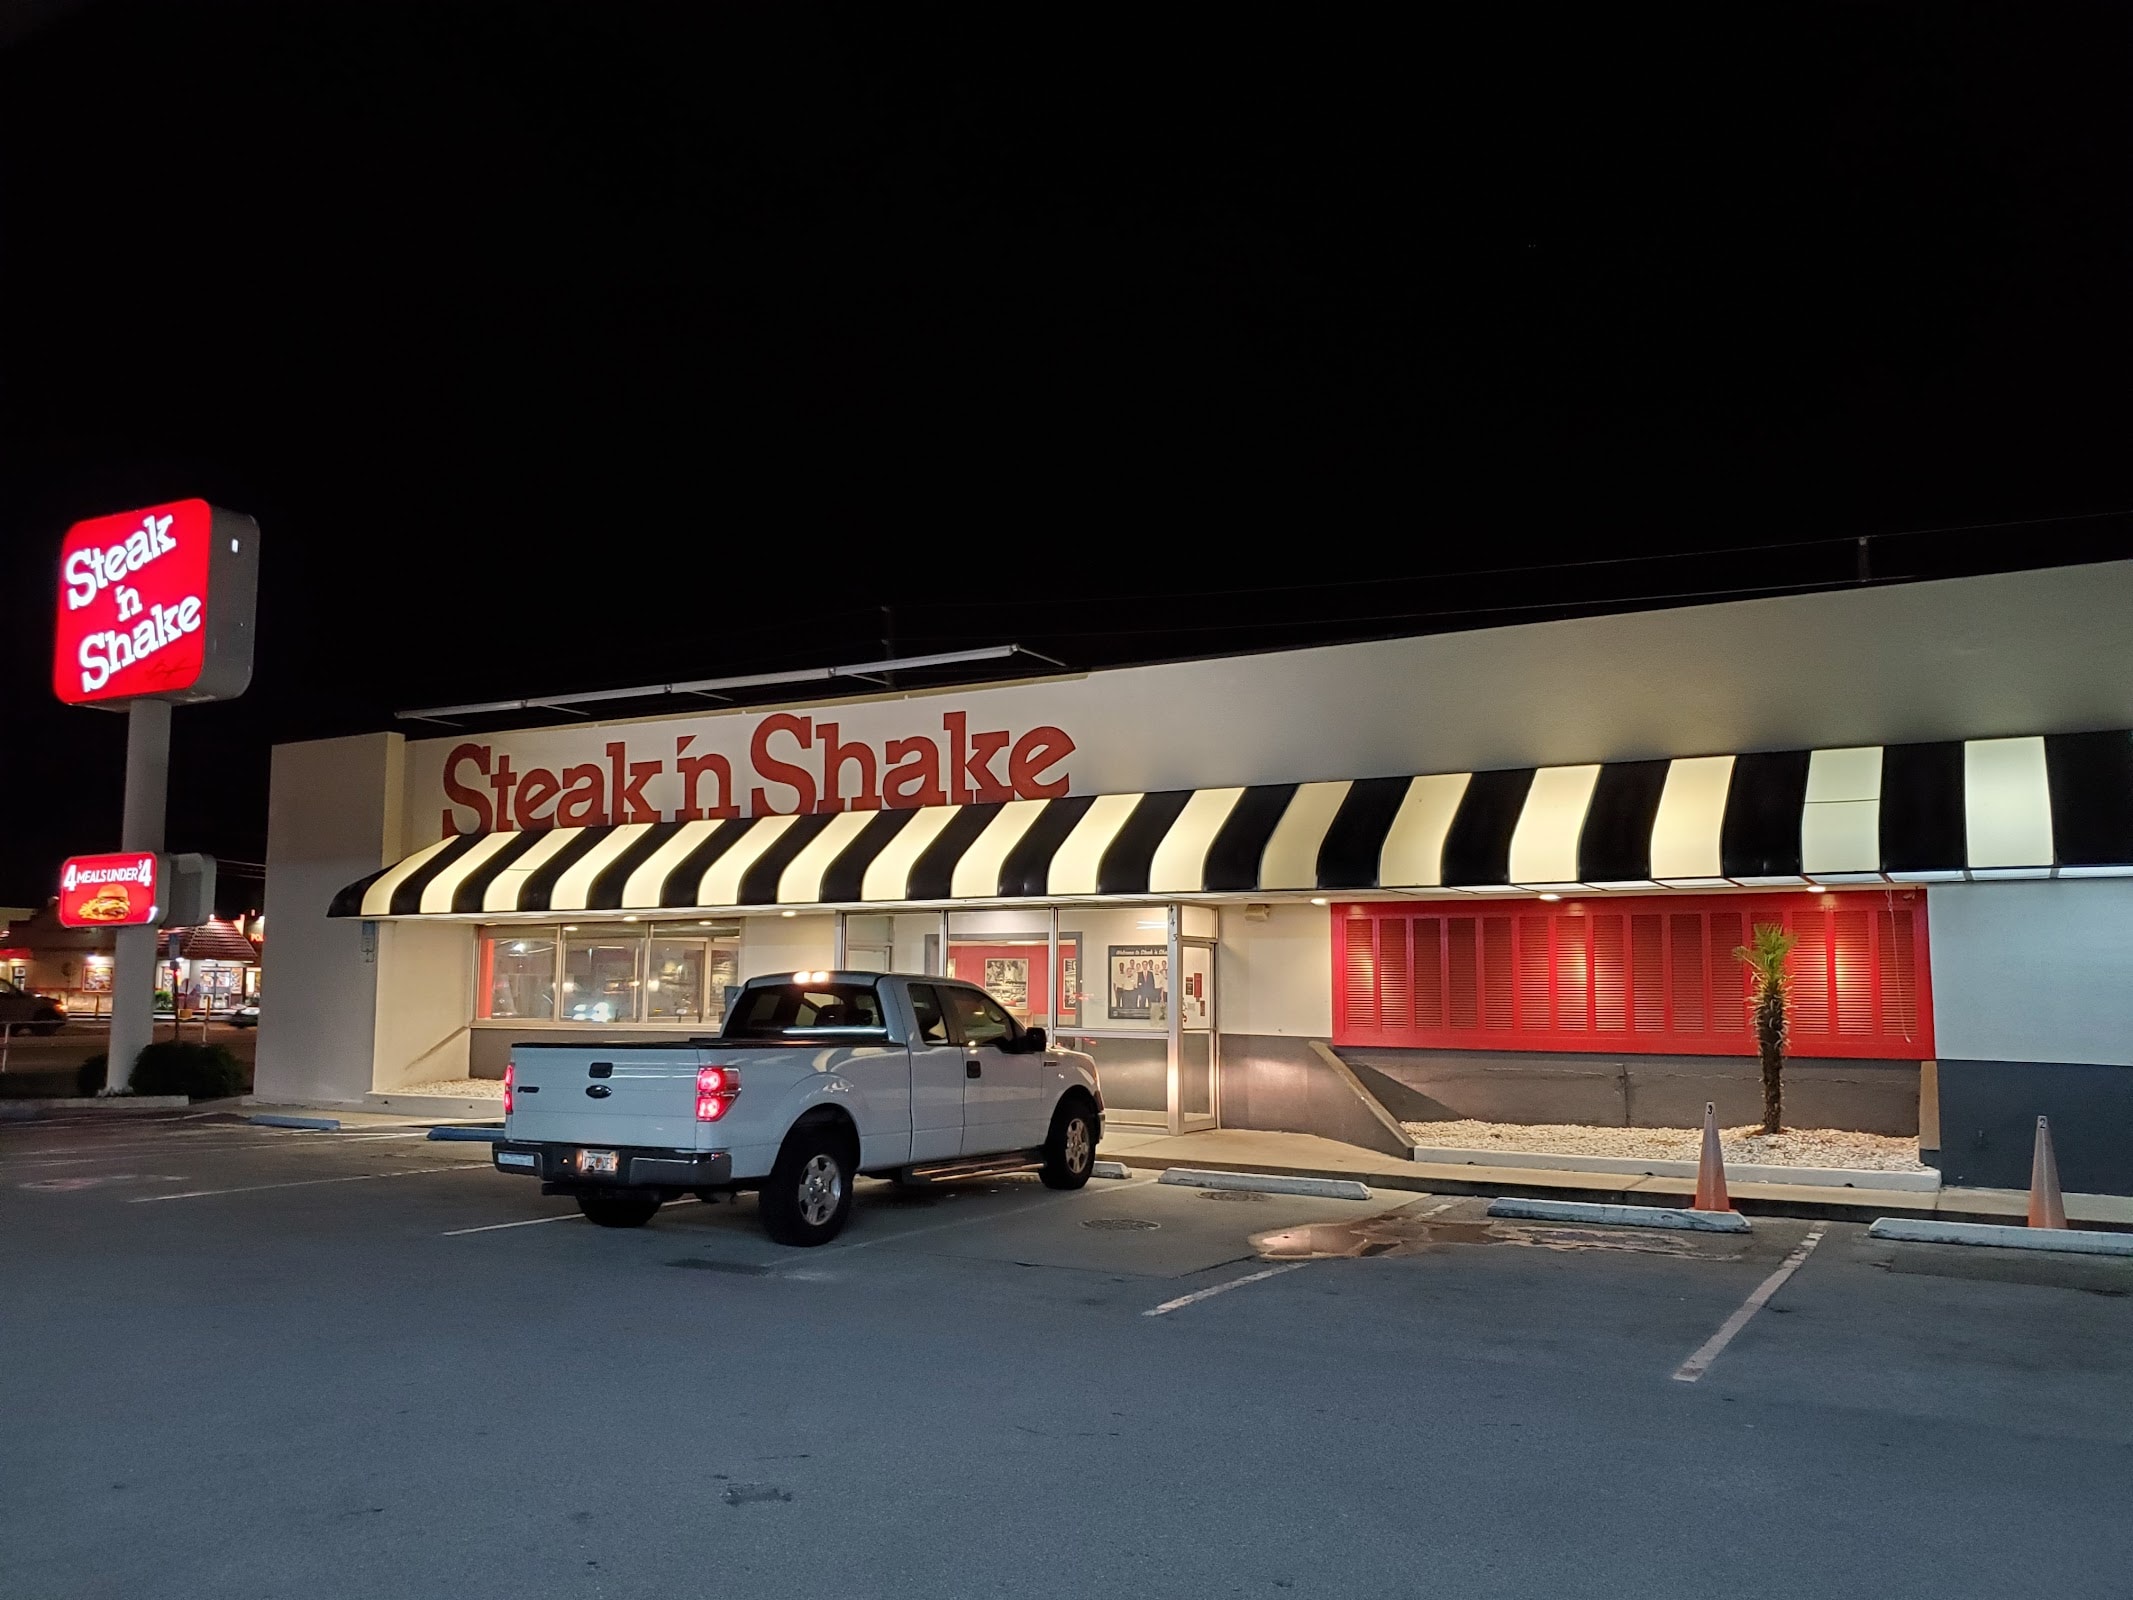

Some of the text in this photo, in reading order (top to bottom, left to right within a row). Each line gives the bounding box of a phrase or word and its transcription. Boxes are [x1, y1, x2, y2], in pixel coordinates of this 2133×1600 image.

[66, 514, 177, 610] Steak
[79, 596, 202, 693] Shake
[442, 743, 662, 838] Steak
[751, 711, 1076, 817] Shake
[63, 864, 77, 892] 4
[76, 869, 107, 884] MEALS
[107, 867, 138, 883] UNDER
[1707, 1104, 1713, 1115] 3
[2039, 1118, 2046, 1129] 2
